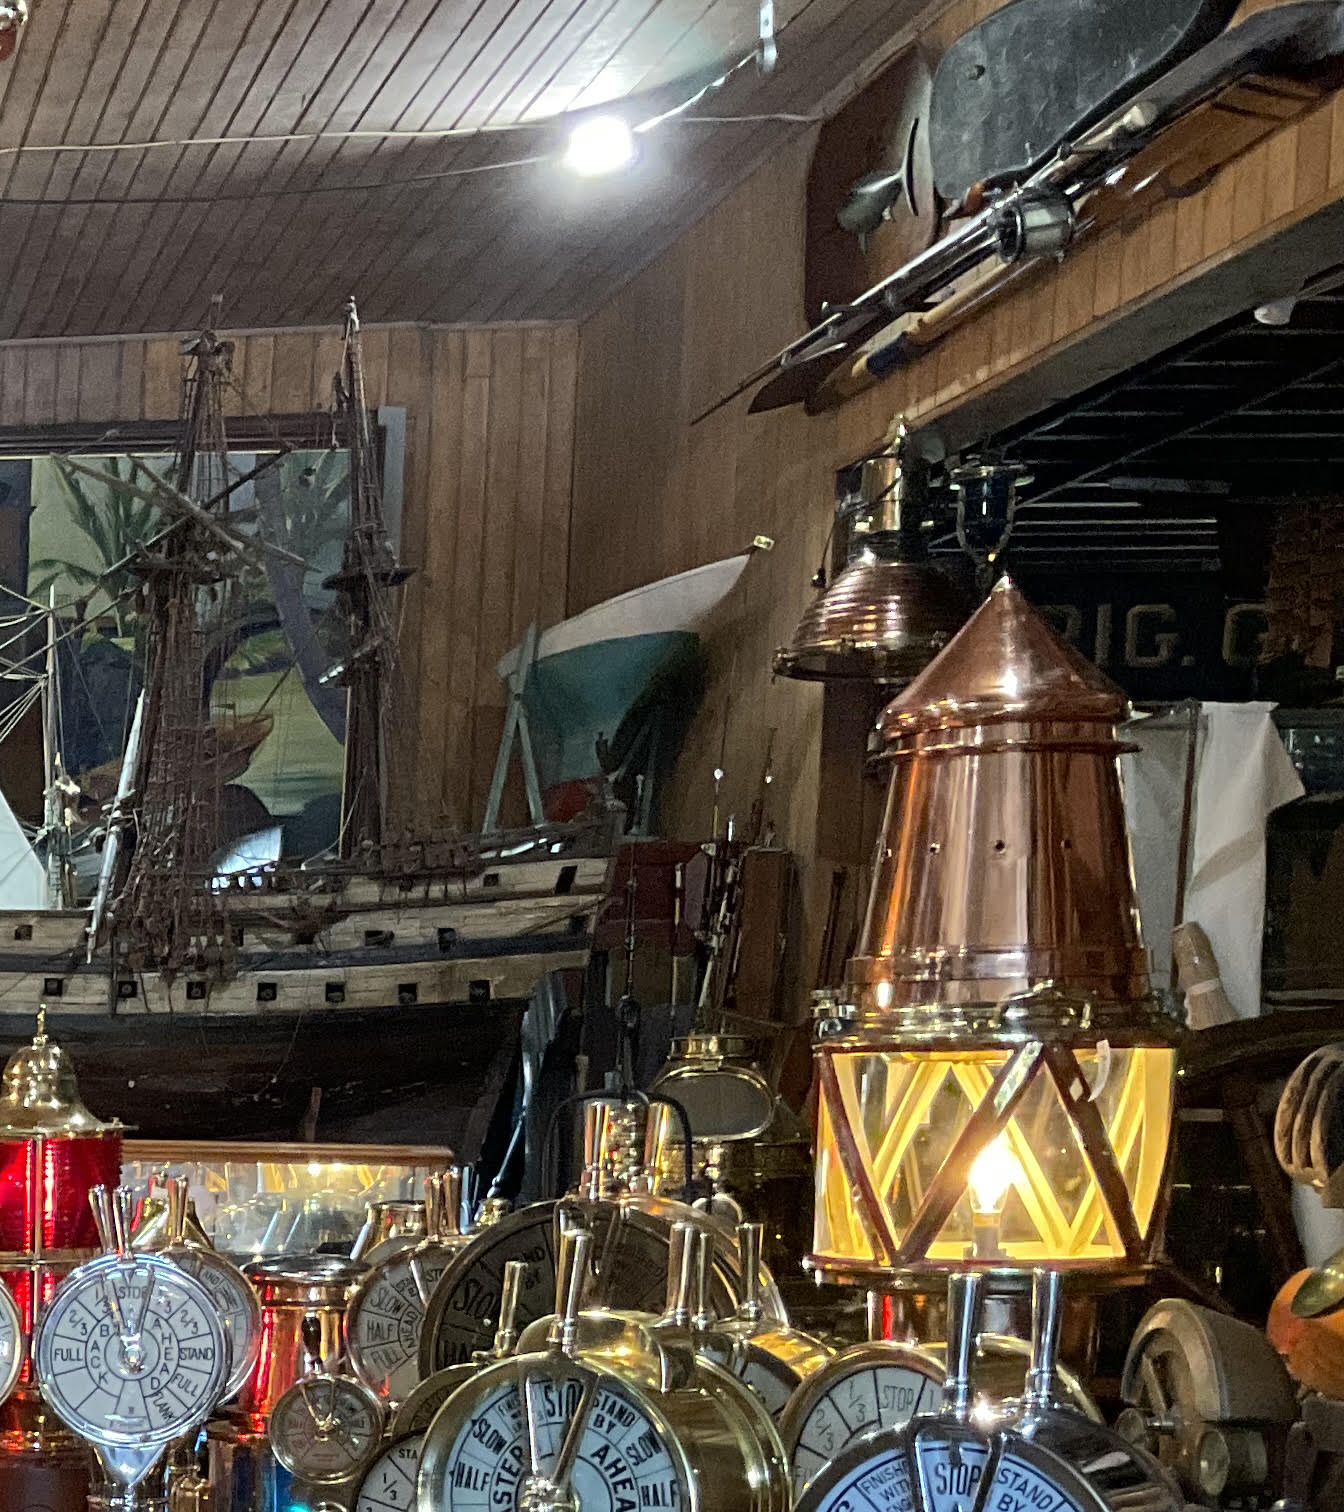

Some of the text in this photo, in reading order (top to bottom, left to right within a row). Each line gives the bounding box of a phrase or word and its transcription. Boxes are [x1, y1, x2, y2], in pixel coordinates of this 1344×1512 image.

[367, 1320, 395, 1343] HALF
[54, 1347, 83, 1362] FULL
[180, 1347, 213, 1361] STAND
[170, 1372, 199, 1398] FULL
[881, 1385, 914, 1411] STOP
[472, 1416, 508, 1459] SLOW
[593, 1414, 617, 1435] BY
[625, 1427, 661, 1467] SLOW
[454, 1462, 491, 1492] HALF
[935, 1464, 983, 1498] STOP
[996, 1469, 1053, 1511] STAND
[640, 1479, 680, 1507] HALF
